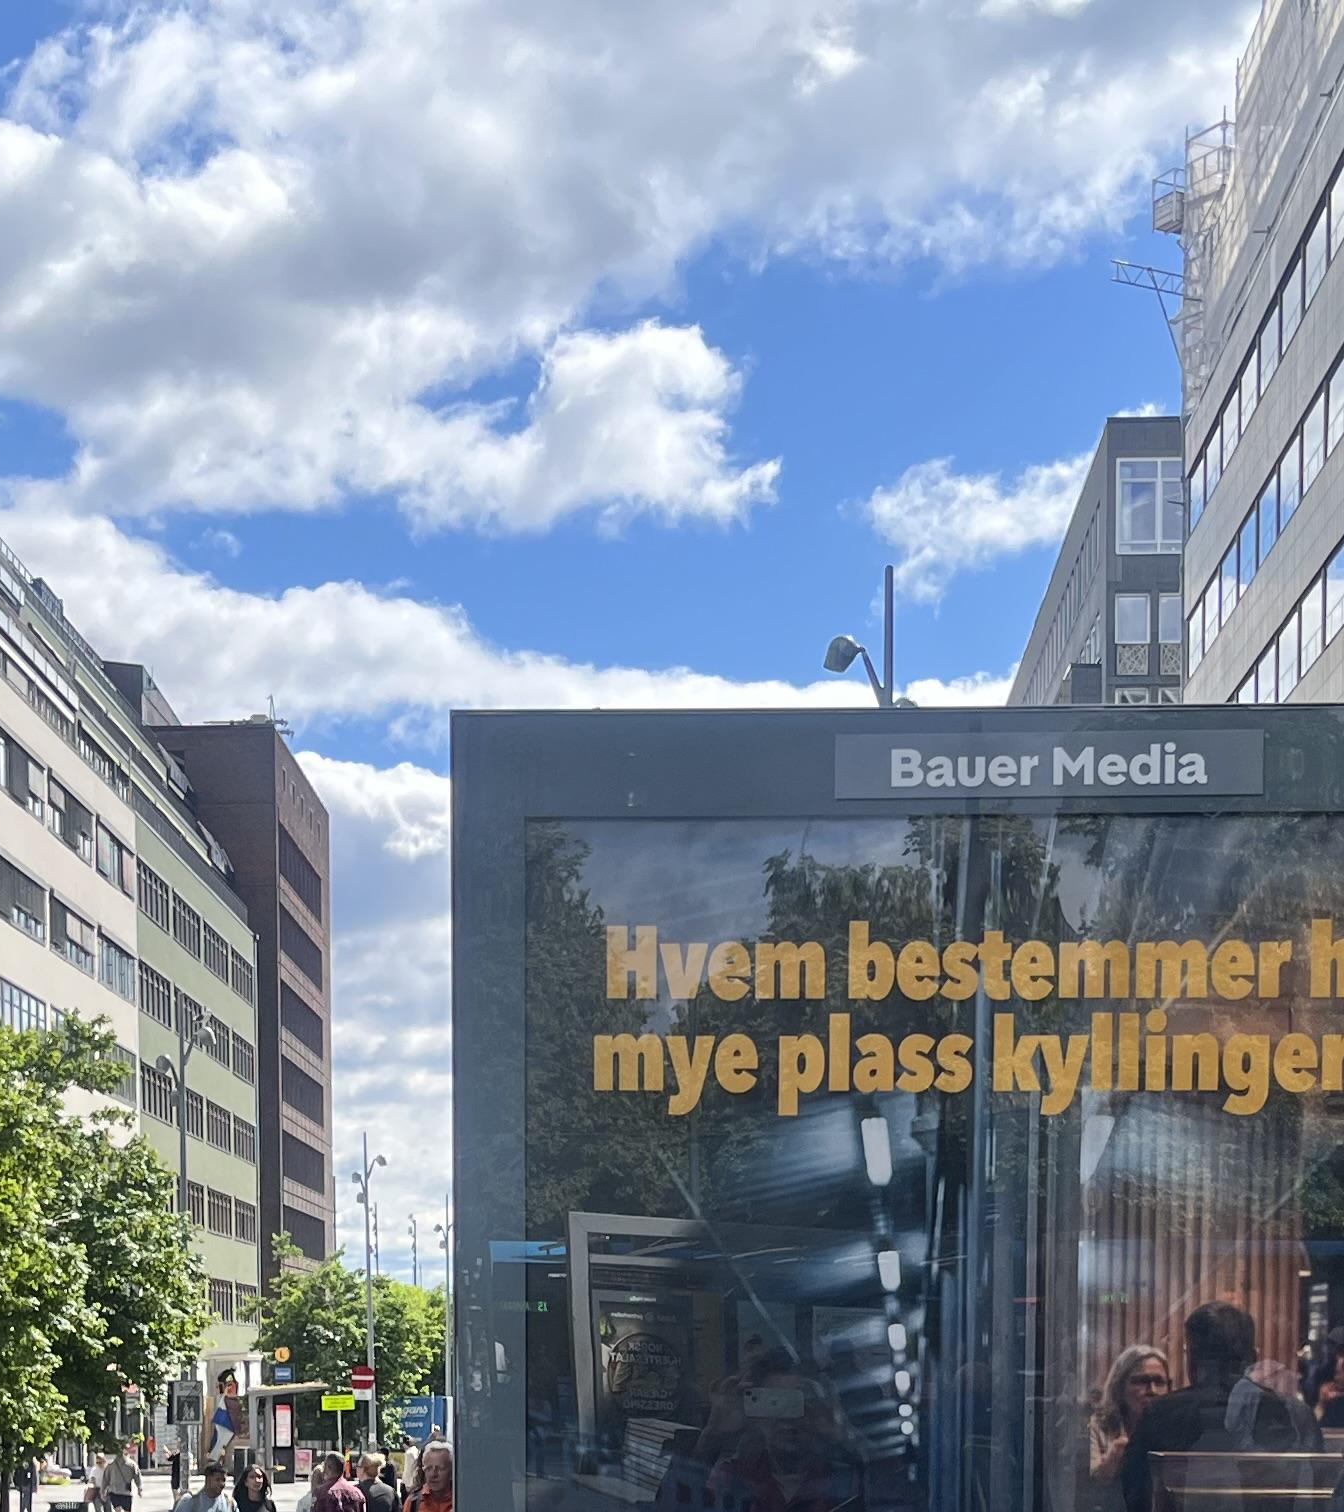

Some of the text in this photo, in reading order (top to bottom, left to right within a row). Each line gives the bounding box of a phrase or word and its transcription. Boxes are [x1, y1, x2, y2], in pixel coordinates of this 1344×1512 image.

[890, 742, 1208, 788] Bauer Media
[606, 924, 826, 1001] Hvem
[847, 919, 1293, 1001] bestemmer
[593, 1032, 759, 1116] mye
[777, 1012, 975, 1116] plass
